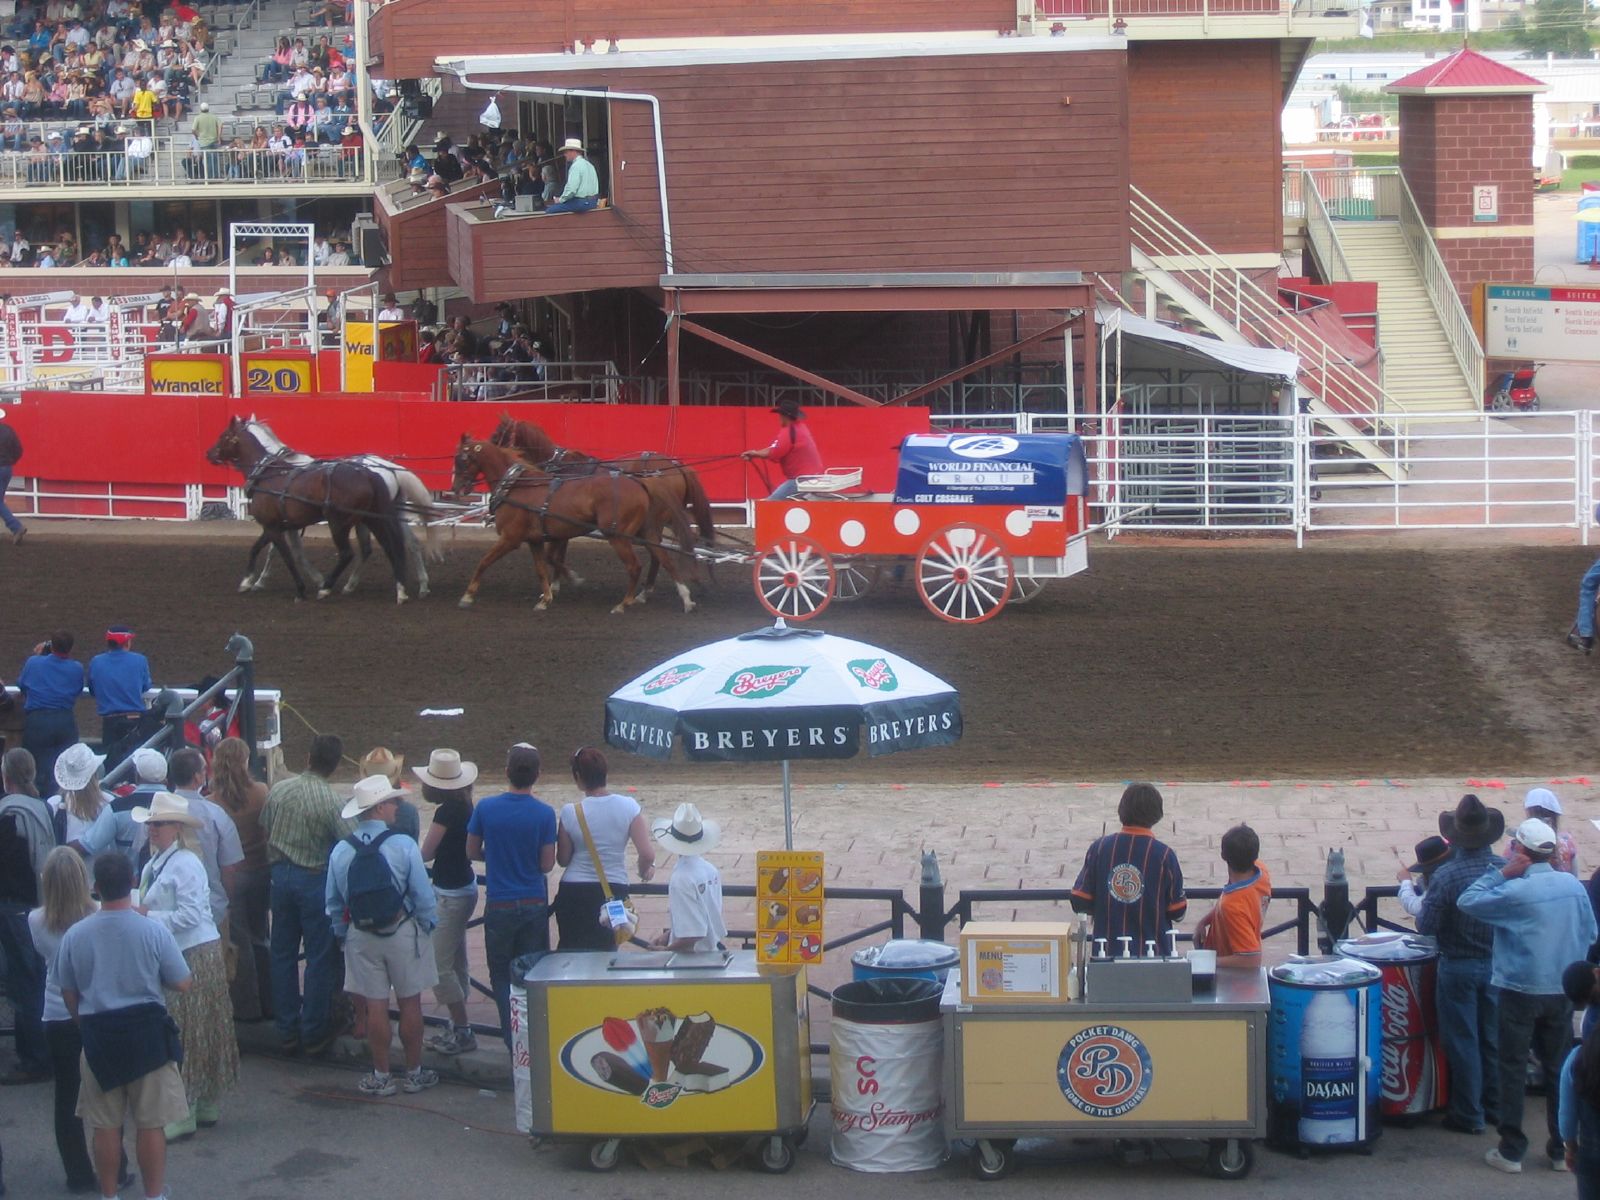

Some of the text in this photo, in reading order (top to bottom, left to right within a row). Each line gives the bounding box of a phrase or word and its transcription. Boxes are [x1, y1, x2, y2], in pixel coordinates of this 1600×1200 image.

[1502, 289, 1536, 297] SEATING
[1567, 292, 1597, 300] SUITES
[151, 377, 222, 393] Wrangler
[248, 367, 301, 392] 20
[929, 462, 1035, 472] WORLD FINANCIAL
[931, 473, 1031, 484] GROUP
[915, 494, 933, 503] COLT
[935, 494, 975, 503] COSGRAVE
[731, 668, 802, 696] Breyers
[870, 712, 952, 744] BREYERS
[694, 726, 848, 750] BREYERS
[979, 951, 1003, 960] MENU
[1069, 1026, 1140, 1048] POCKET DAWG
[1306, 1081, 1354, 1099] DASANI
[1064, 1086, 1147, 1116] HOME OF THE ORIGINAL
